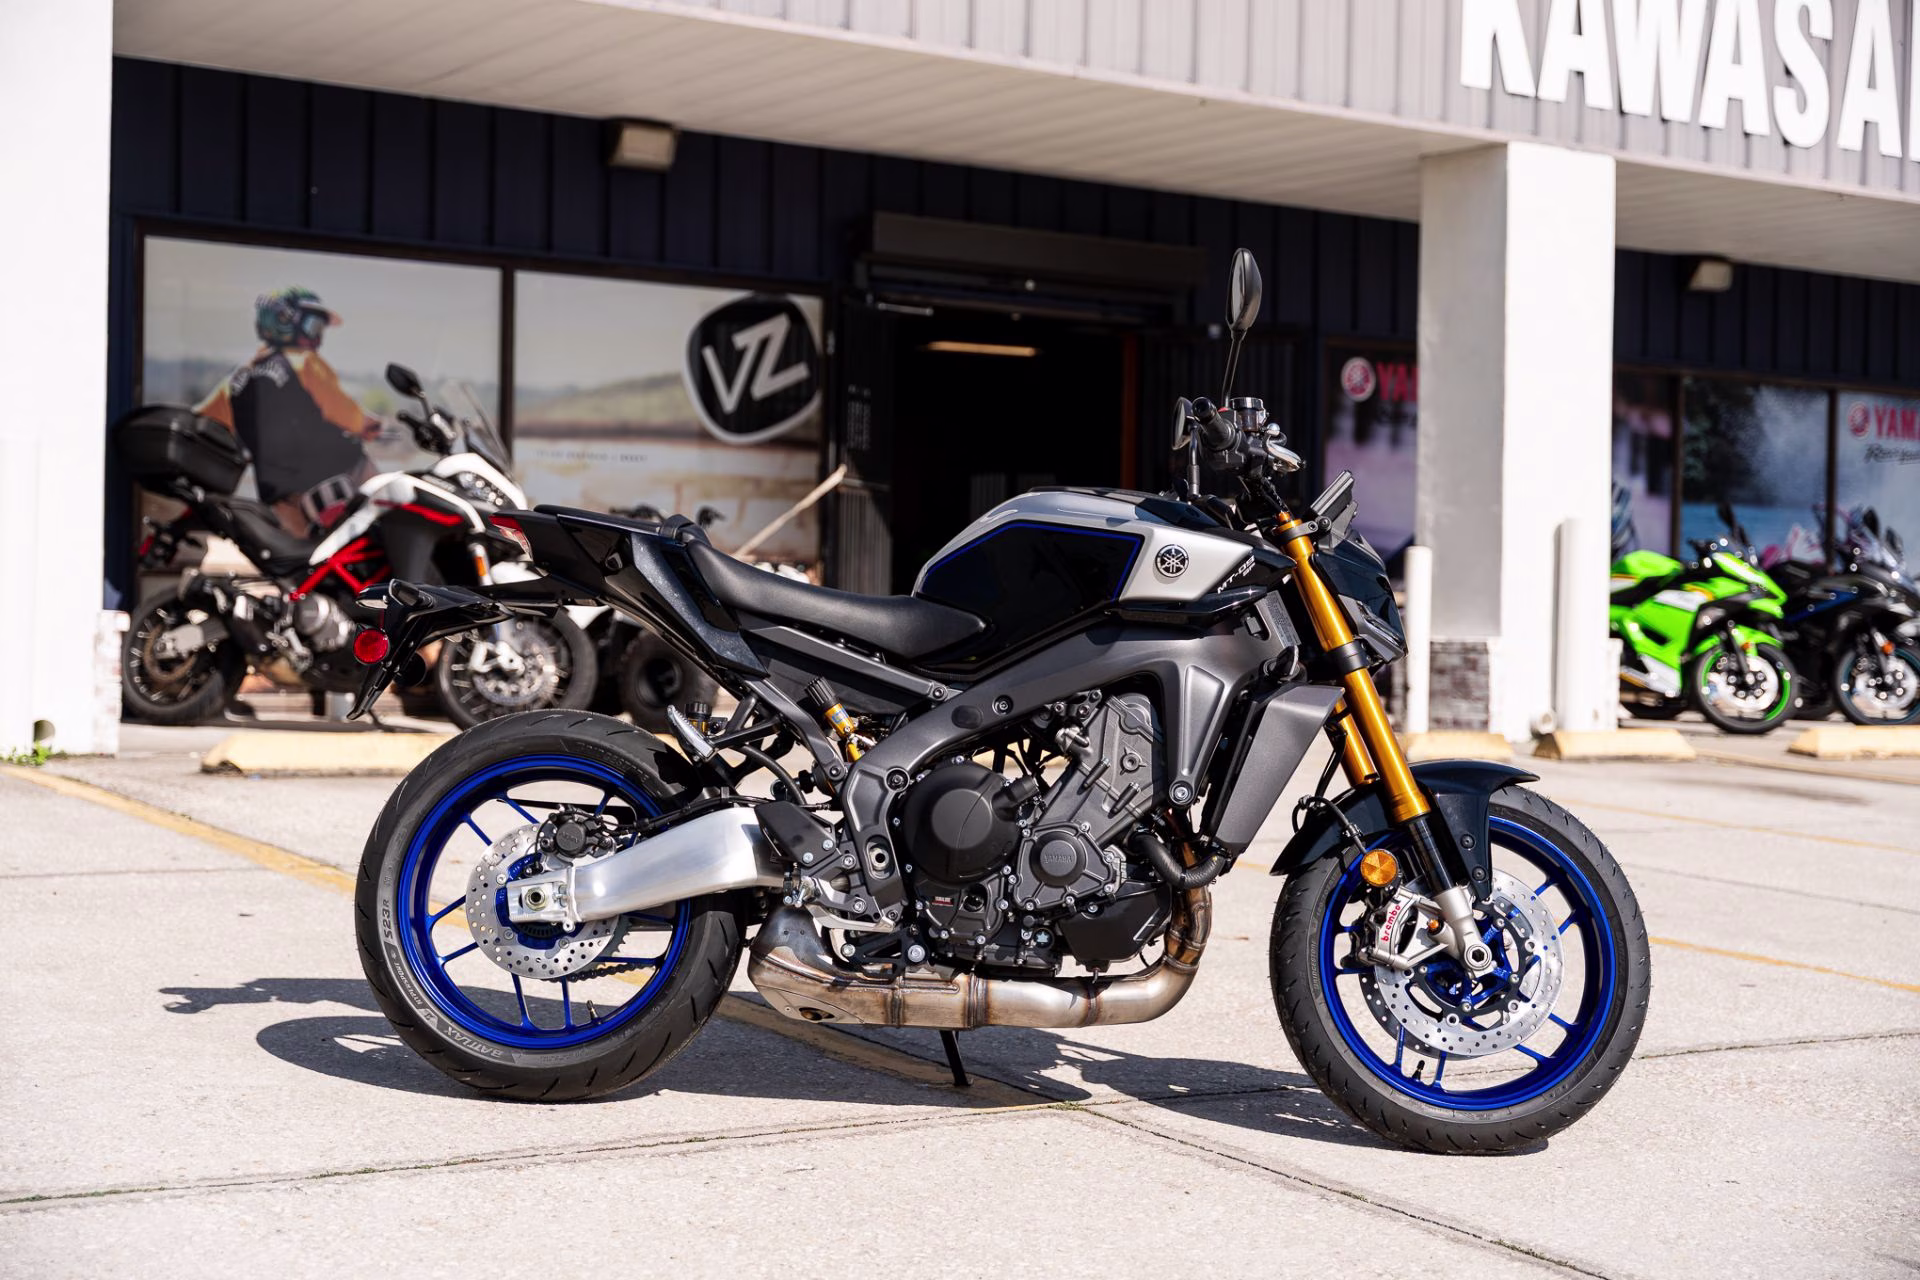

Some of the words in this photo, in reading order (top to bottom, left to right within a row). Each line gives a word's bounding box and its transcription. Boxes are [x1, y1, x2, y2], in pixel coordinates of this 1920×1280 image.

[1461, 0, 1920, 161] KAWASA
[702, 312, 810, 414] VZ
[1874, 403, 1920, 440] YAM
[1217, 555, 1255, 594] MT-09
[382, 899, 394, 940] S23R
[1380, 904, 1401, 942] brembo
[394, 962, 424, 1006] HYPERSPORT
[443, 1025, 504, 1059] BATTLAX
